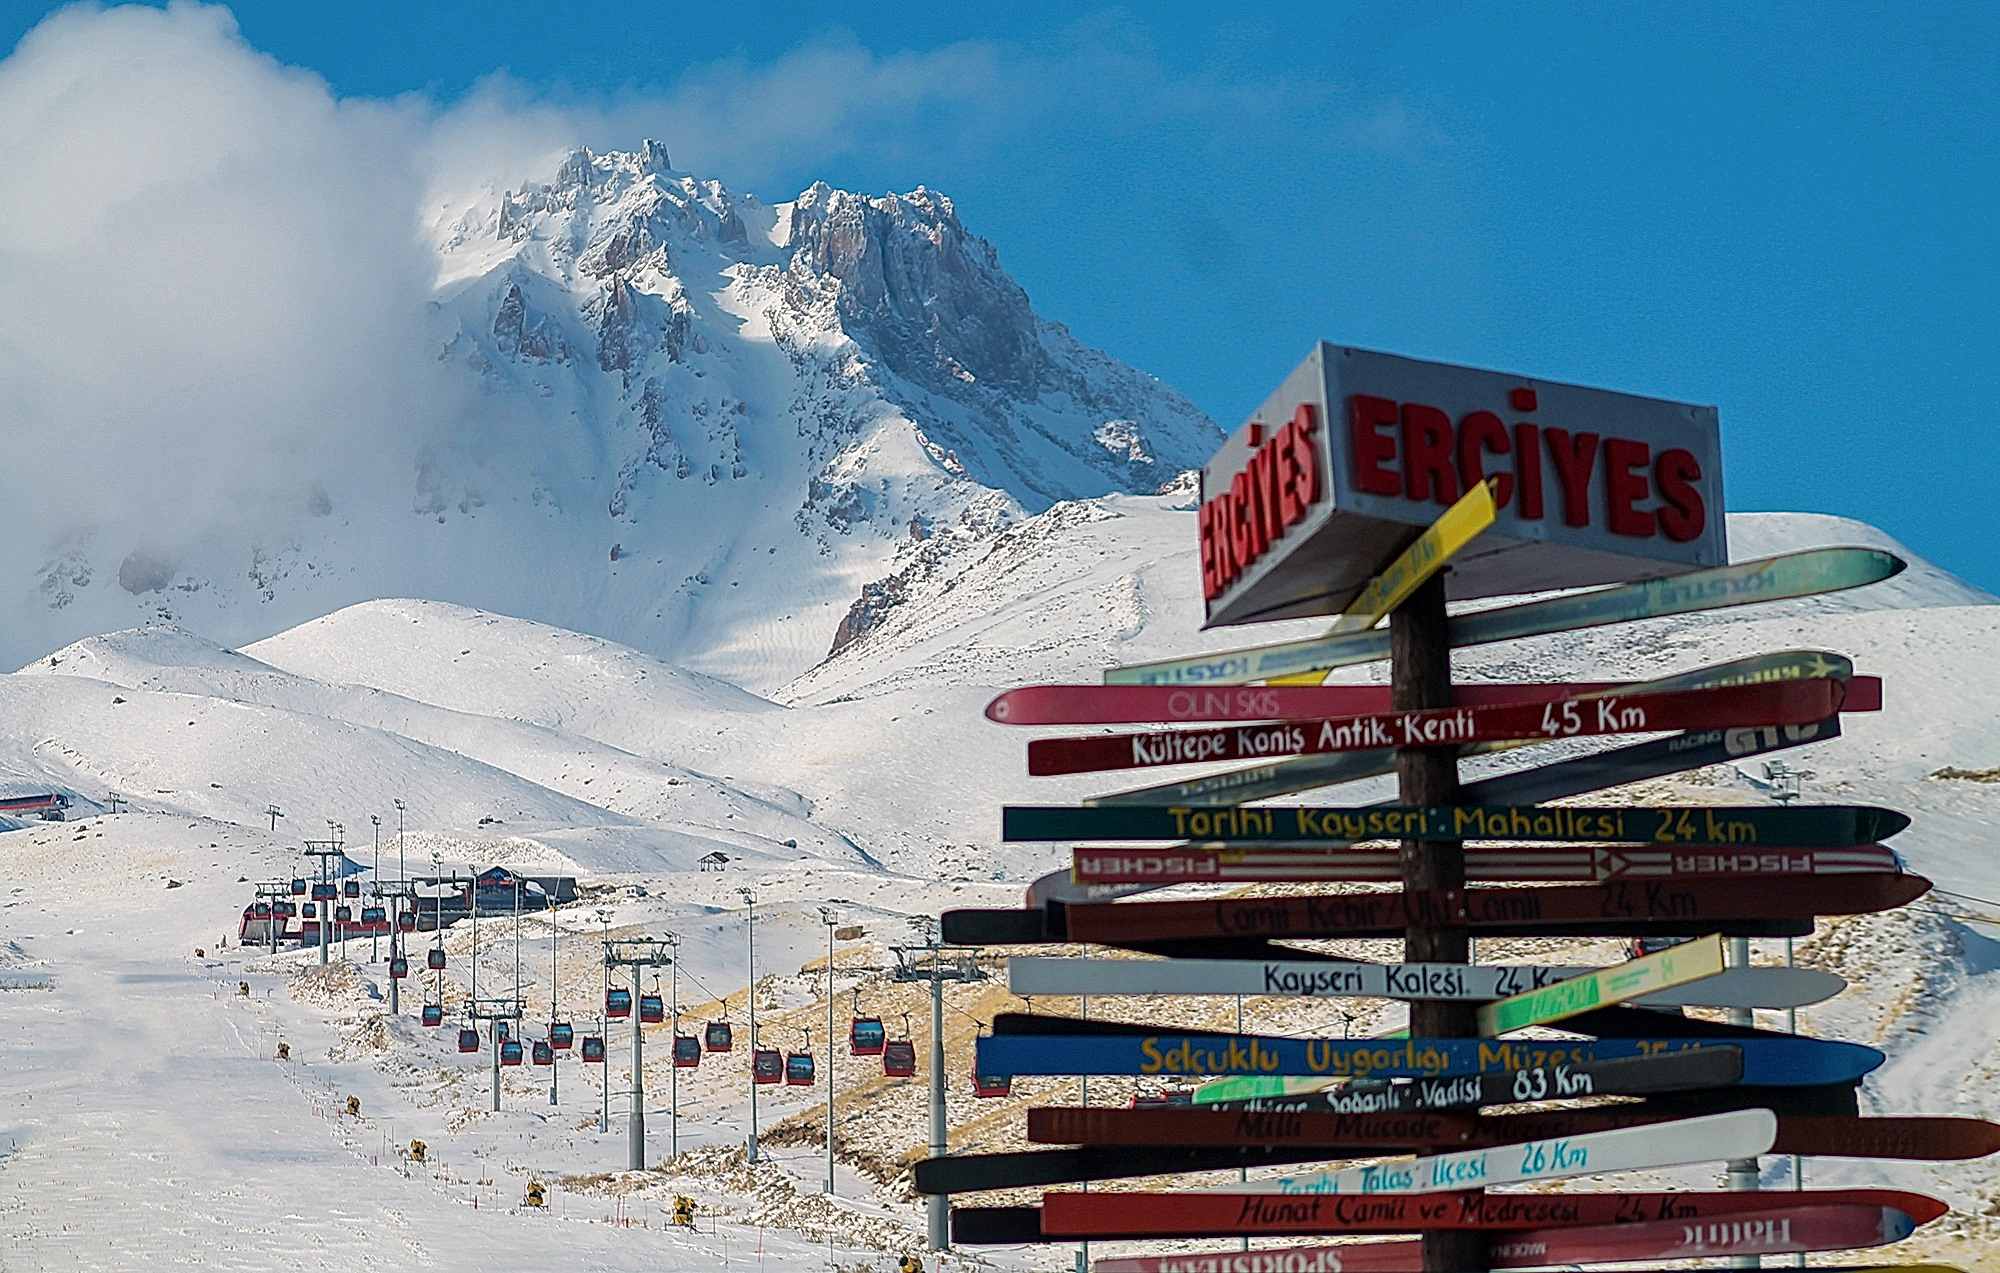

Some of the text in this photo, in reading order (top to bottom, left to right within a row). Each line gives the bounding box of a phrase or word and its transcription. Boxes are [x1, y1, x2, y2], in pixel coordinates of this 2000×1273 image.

[1349, 387, 1706, 542] ERCİYES
[1167, 691, 1280, 717] OLIN SKIS
[1131, 733, 1226, 764] Kültepe
[1404, 710, 1473, 743] Kenti
[1541, 701, 1581, 735] 45
[1598, 701, 1645, 731] Km
[1297, 808, 1428, 838] Kayseri
[1453, 807, 1624, 836] Mahallesi
[1654, 809, 1696, 842] 24
[1706, 810, 1758, 843] km
[1082, 856, 1217, 875] FISCHER
[1677, 852, 1811, 873] FISCHER
[1264, 965, 1363, 995] Kayseri
[1494, 966, 1523, 997] 24
[1532, 965, 1568, 988] K
[1421, 1075, 1482, 1106] Vadisi
[1513, 1067, 1548, 1100] 83
[1555, 1064, 1593, 1096] Km
[1360, 1165, 1412, 1191] Talas
[1521, 1143, 1547, 1176] 26
[1553, 1142, 1587, 1170] Km
[1237, 1197, 1320, 1225] Hunat
[1420, 1204, 1447, 1219] ve
[1657, 1195, 1698, 1220] Km
